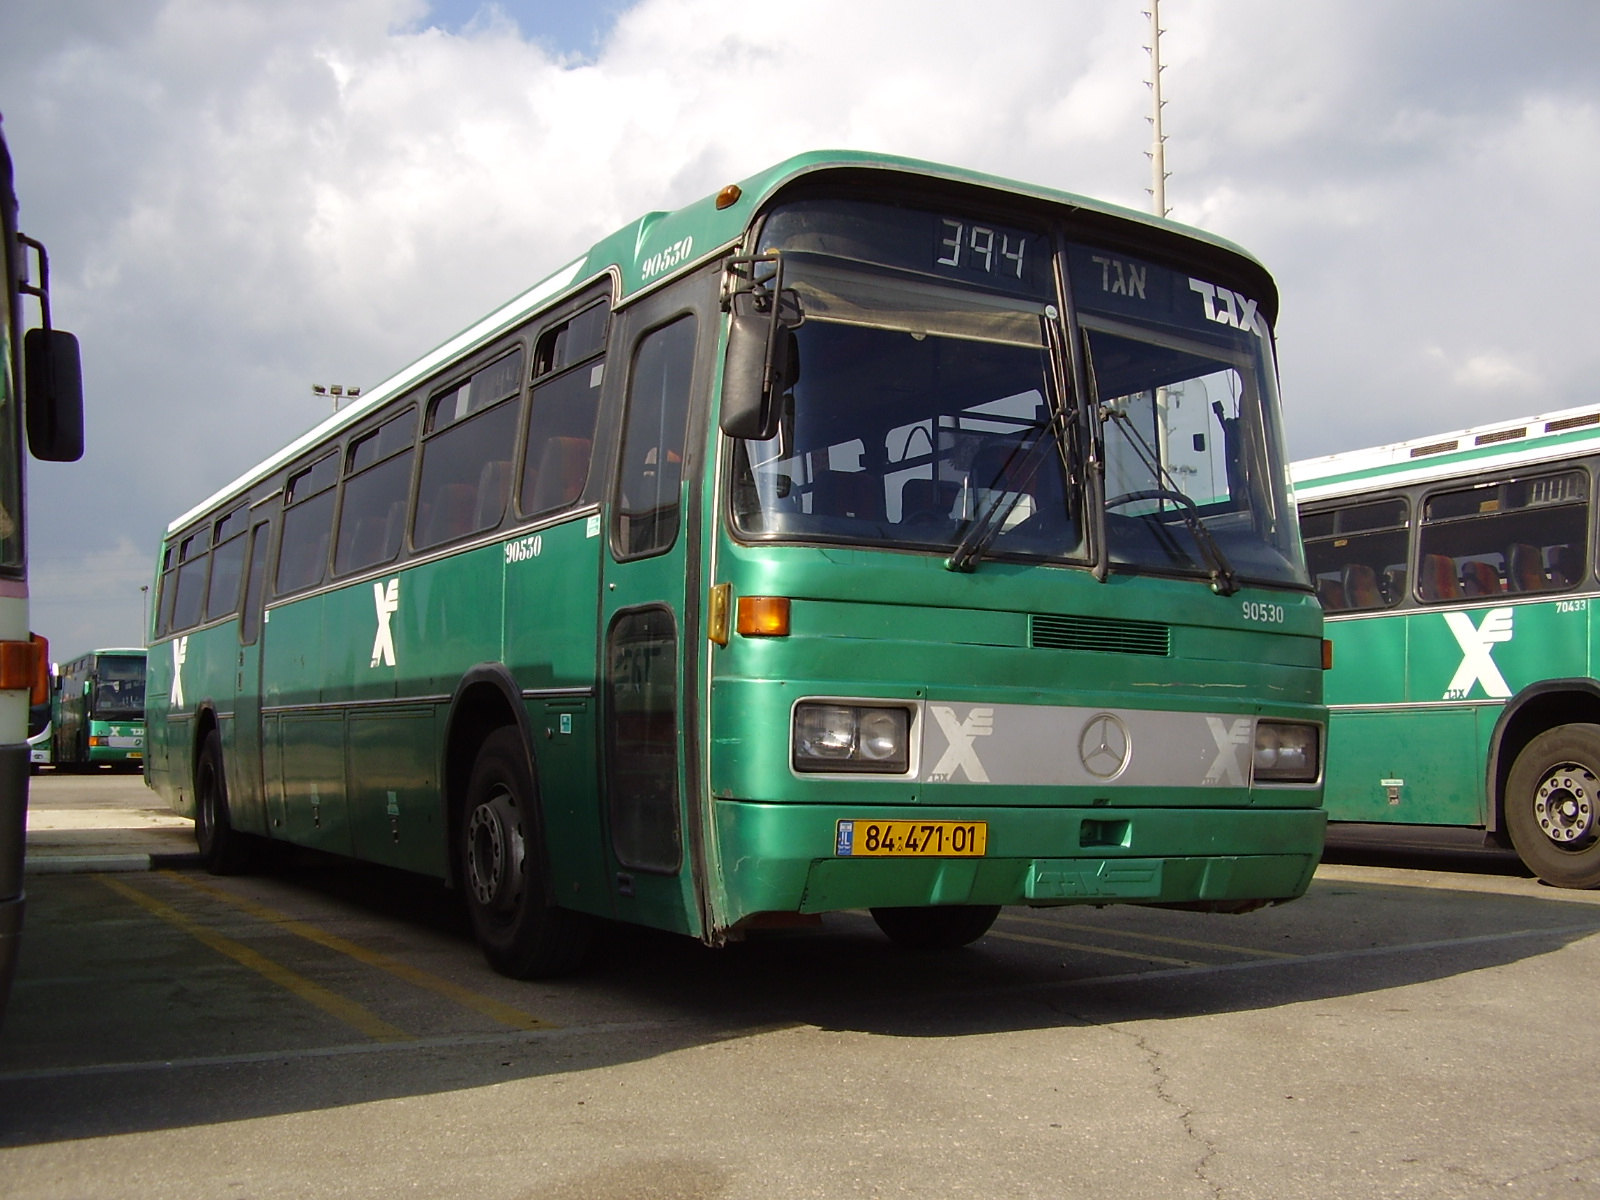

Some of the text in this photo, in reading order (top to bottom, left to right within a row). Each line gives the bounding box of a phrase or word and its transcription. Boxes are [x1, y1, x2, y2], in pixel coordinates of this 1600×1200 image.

[641, 235, 693, 281] 90530
[937, 218, 1025, 279] 394
[1092, 255, 1147, 300] אגד
[1188, 277, 1263, 338] אגד
[505, 535, 543, 564] 90530
[1242, 601, 1285, 624] 90530
[1555, 600, 1587, 614] 70433
[840, 831, 850, 846] IL
